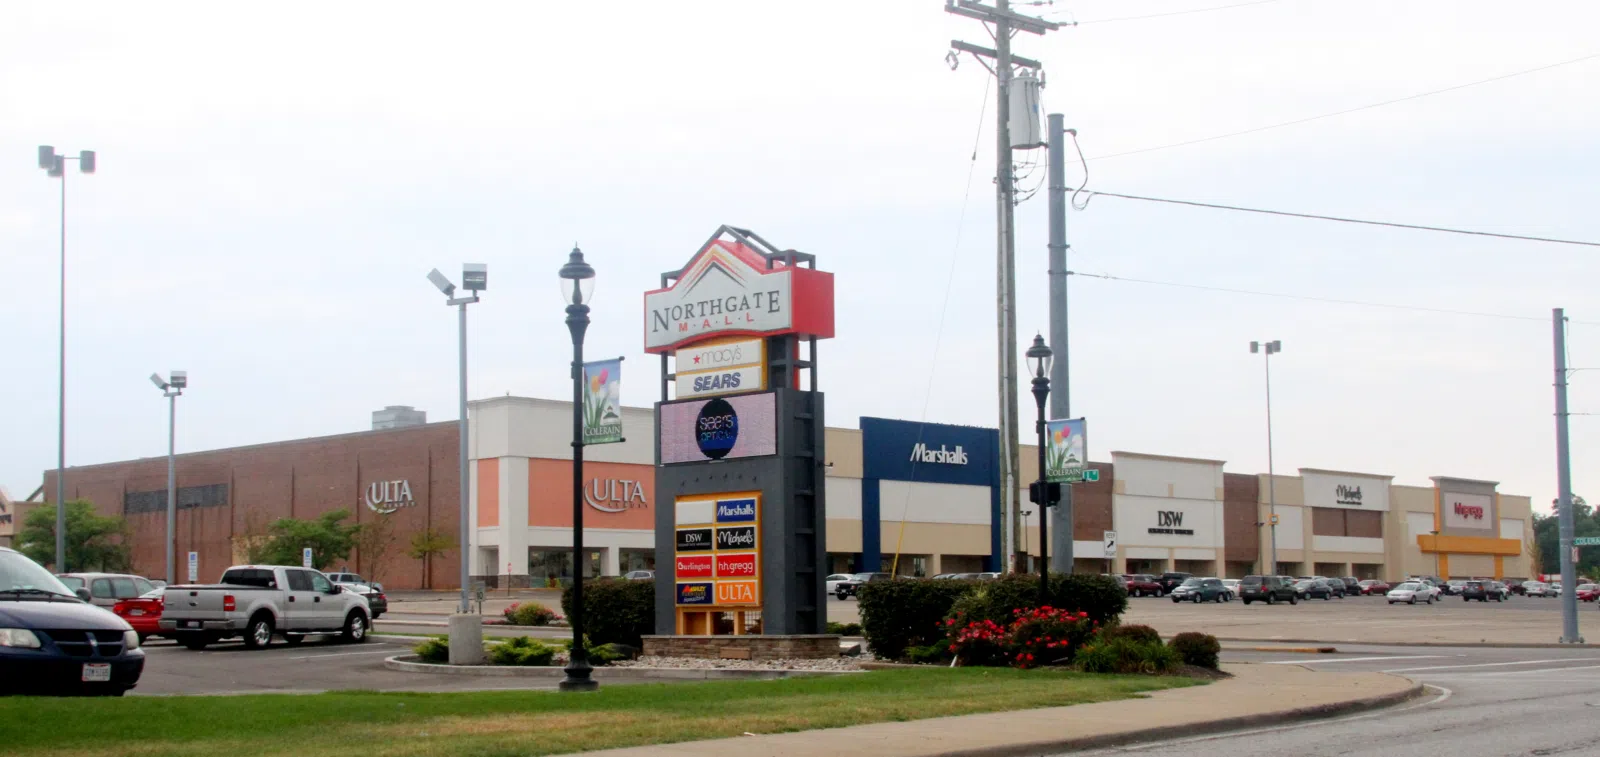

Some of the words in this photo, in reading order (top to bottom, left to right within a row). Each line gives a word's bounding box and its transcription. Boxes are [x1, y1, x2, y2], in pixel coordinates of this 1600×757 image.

[652, 290, 780, 332] NORTHGATE
[701, 345, 742, 363] macy's
[693, 372, 741, 392] SEARS
[584, 425, 621, 436] COLERAIN
[910, 442, 968, 465] Marshalls
[1047, 468, 1081, 477] COLERAIN
[372, 479, 413, 504] ULTA
[593, 477, 647, 503] ULTA
[717, 504, 754, 516] Marshalls
[1157, 510, 1184, 527] DSW
[685, 533, 702, 542] DSW
[717, 529, 753, 546] Michaels
[677, 562, 711, 572] Burlington
[719, 584, 753, 600] ULTA
